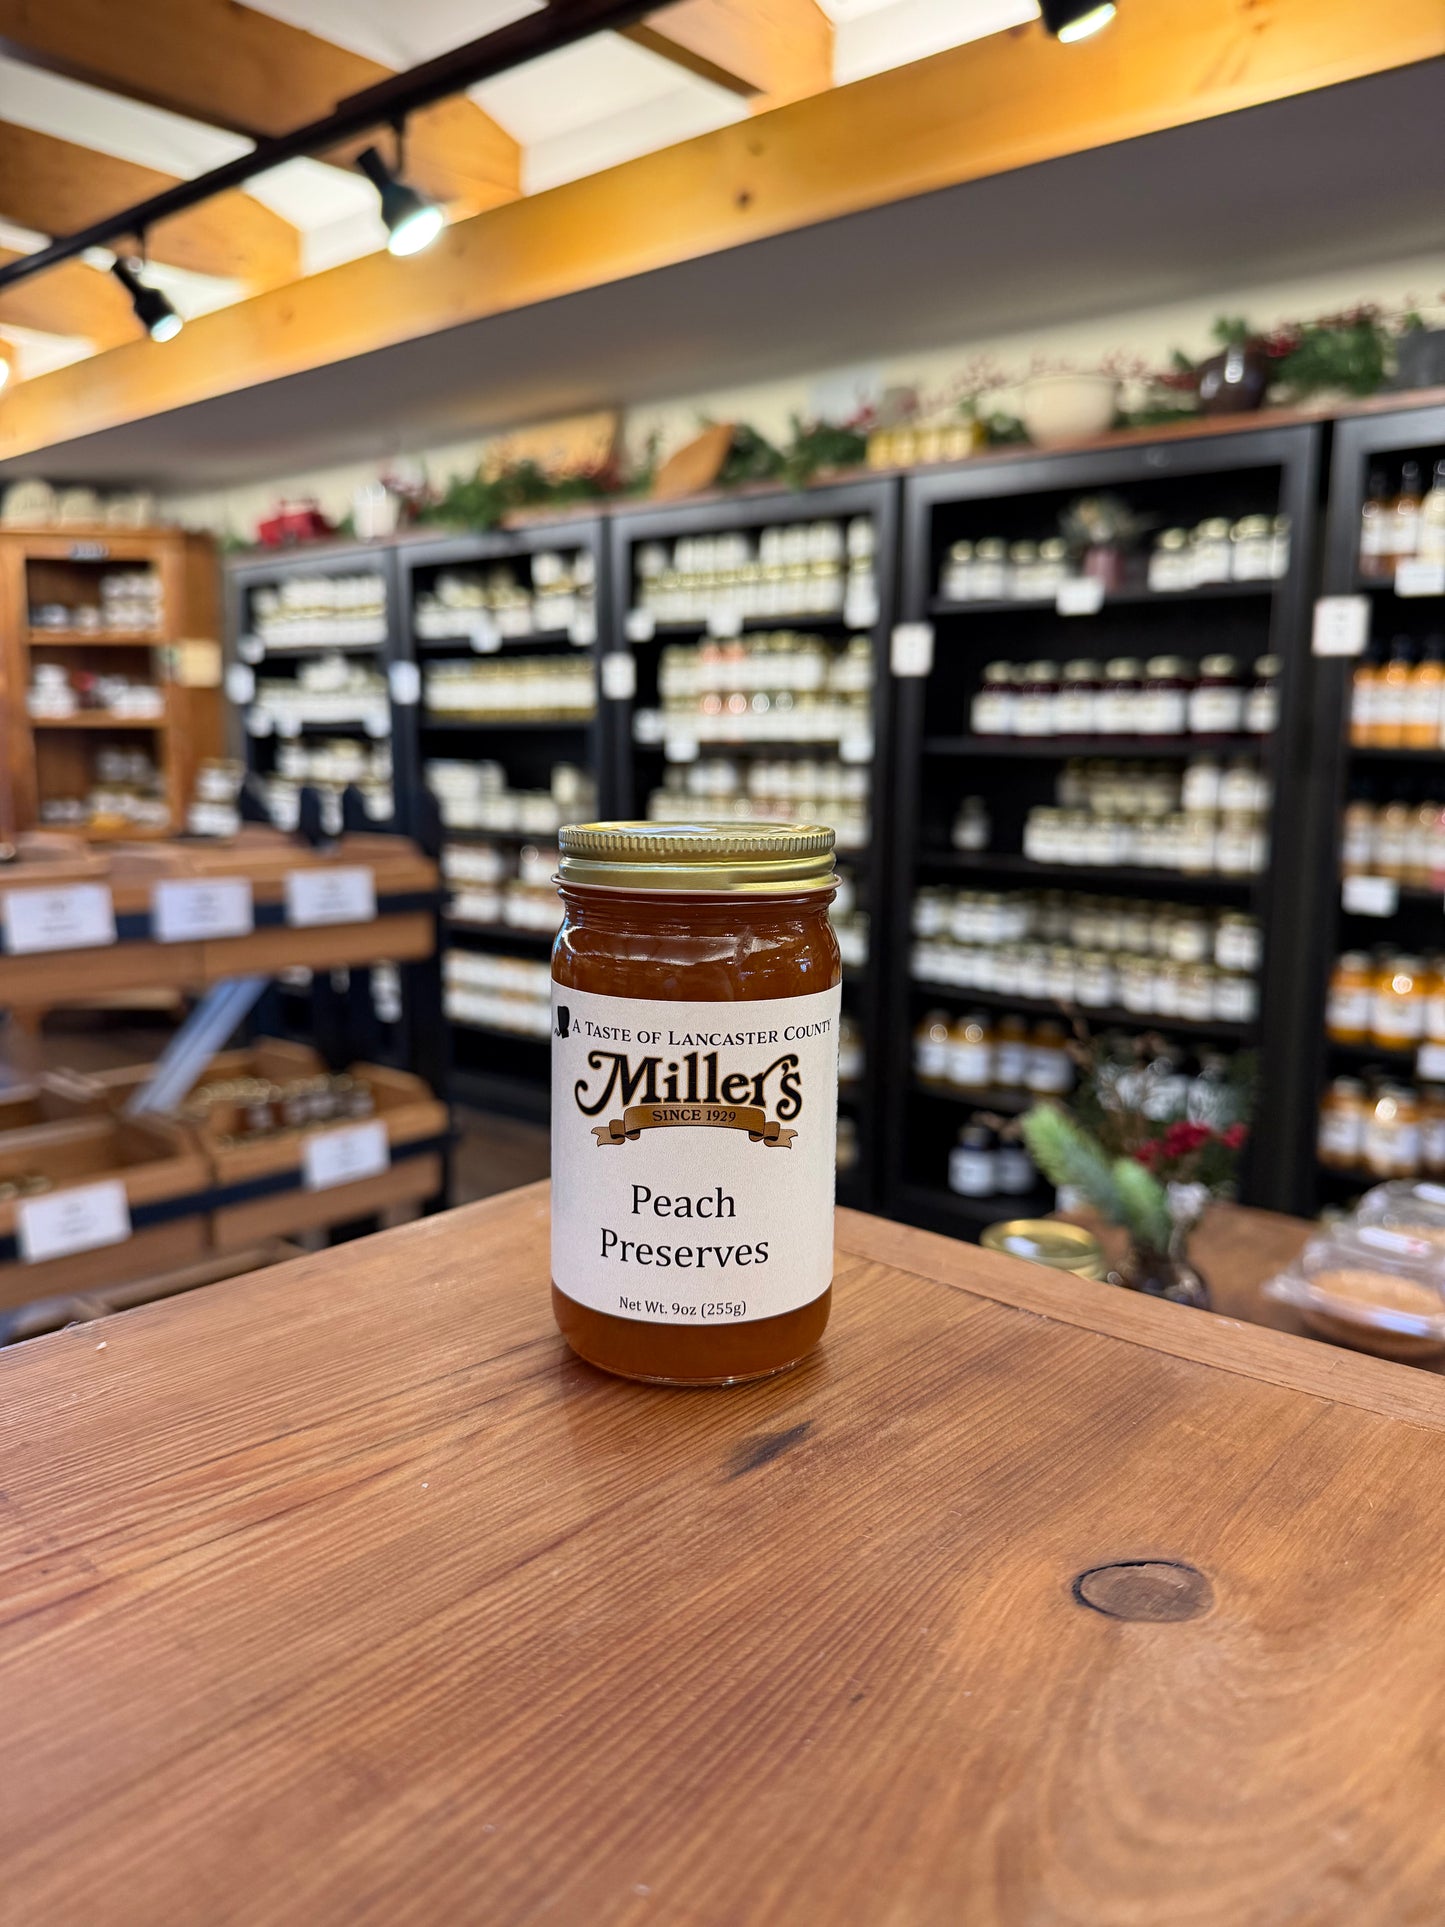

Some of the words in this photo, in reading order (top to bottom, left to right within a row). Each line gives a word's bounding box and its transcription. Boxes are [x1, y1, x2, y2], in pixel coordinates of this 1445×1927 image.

[572, 1018, 582, 1034] A
[584, 1020, 632, 1043] TASTE
[636, 1030, 662, 1045] OF
[668, 1029, 779, 1046] LANCASTER
[783, 1018, 831, 1042] COUNTY
[574, 1050, 802, 1121] Miller's
[652, 1109, 702, 1122] SINCE
[706, 1109, 737, 1123] 1929
[631, 1184, 737, 1218] Peach
[600, 1227, 769, 1268] Preserves
[619, 1296, 642, 1312] Net
[644, 1299, 668, 1315] Wt.
[671, 1302, 697, 1316] 9oz
[701, 1300, 747, 1318] (255g)
